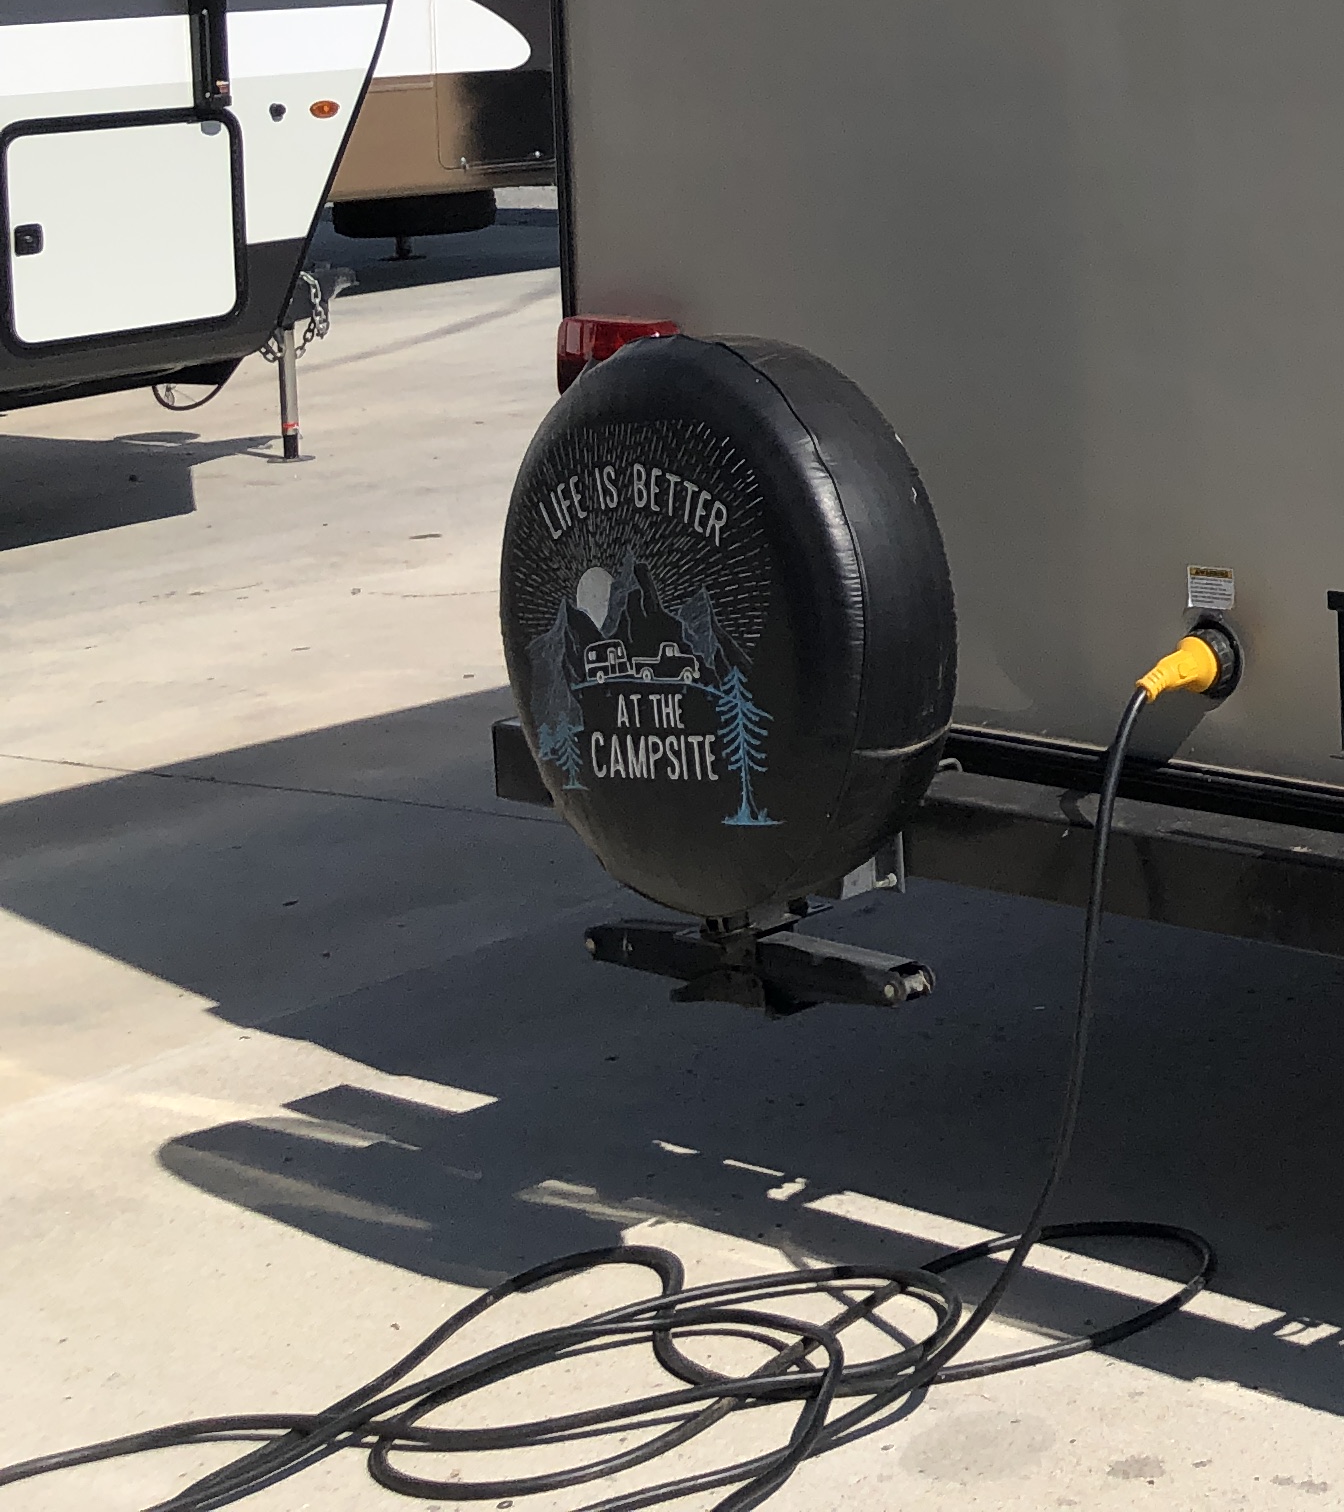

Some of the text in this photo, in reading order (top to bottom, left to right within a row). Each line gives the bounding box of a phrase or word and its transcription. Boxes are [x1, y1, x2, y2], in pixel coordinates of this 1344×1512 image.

[539, 462, 728, 547] LIFE IS BETTER
[617, 693, 685, 729] AT THE
[591, 731, 719, 781] CAMPSITE
